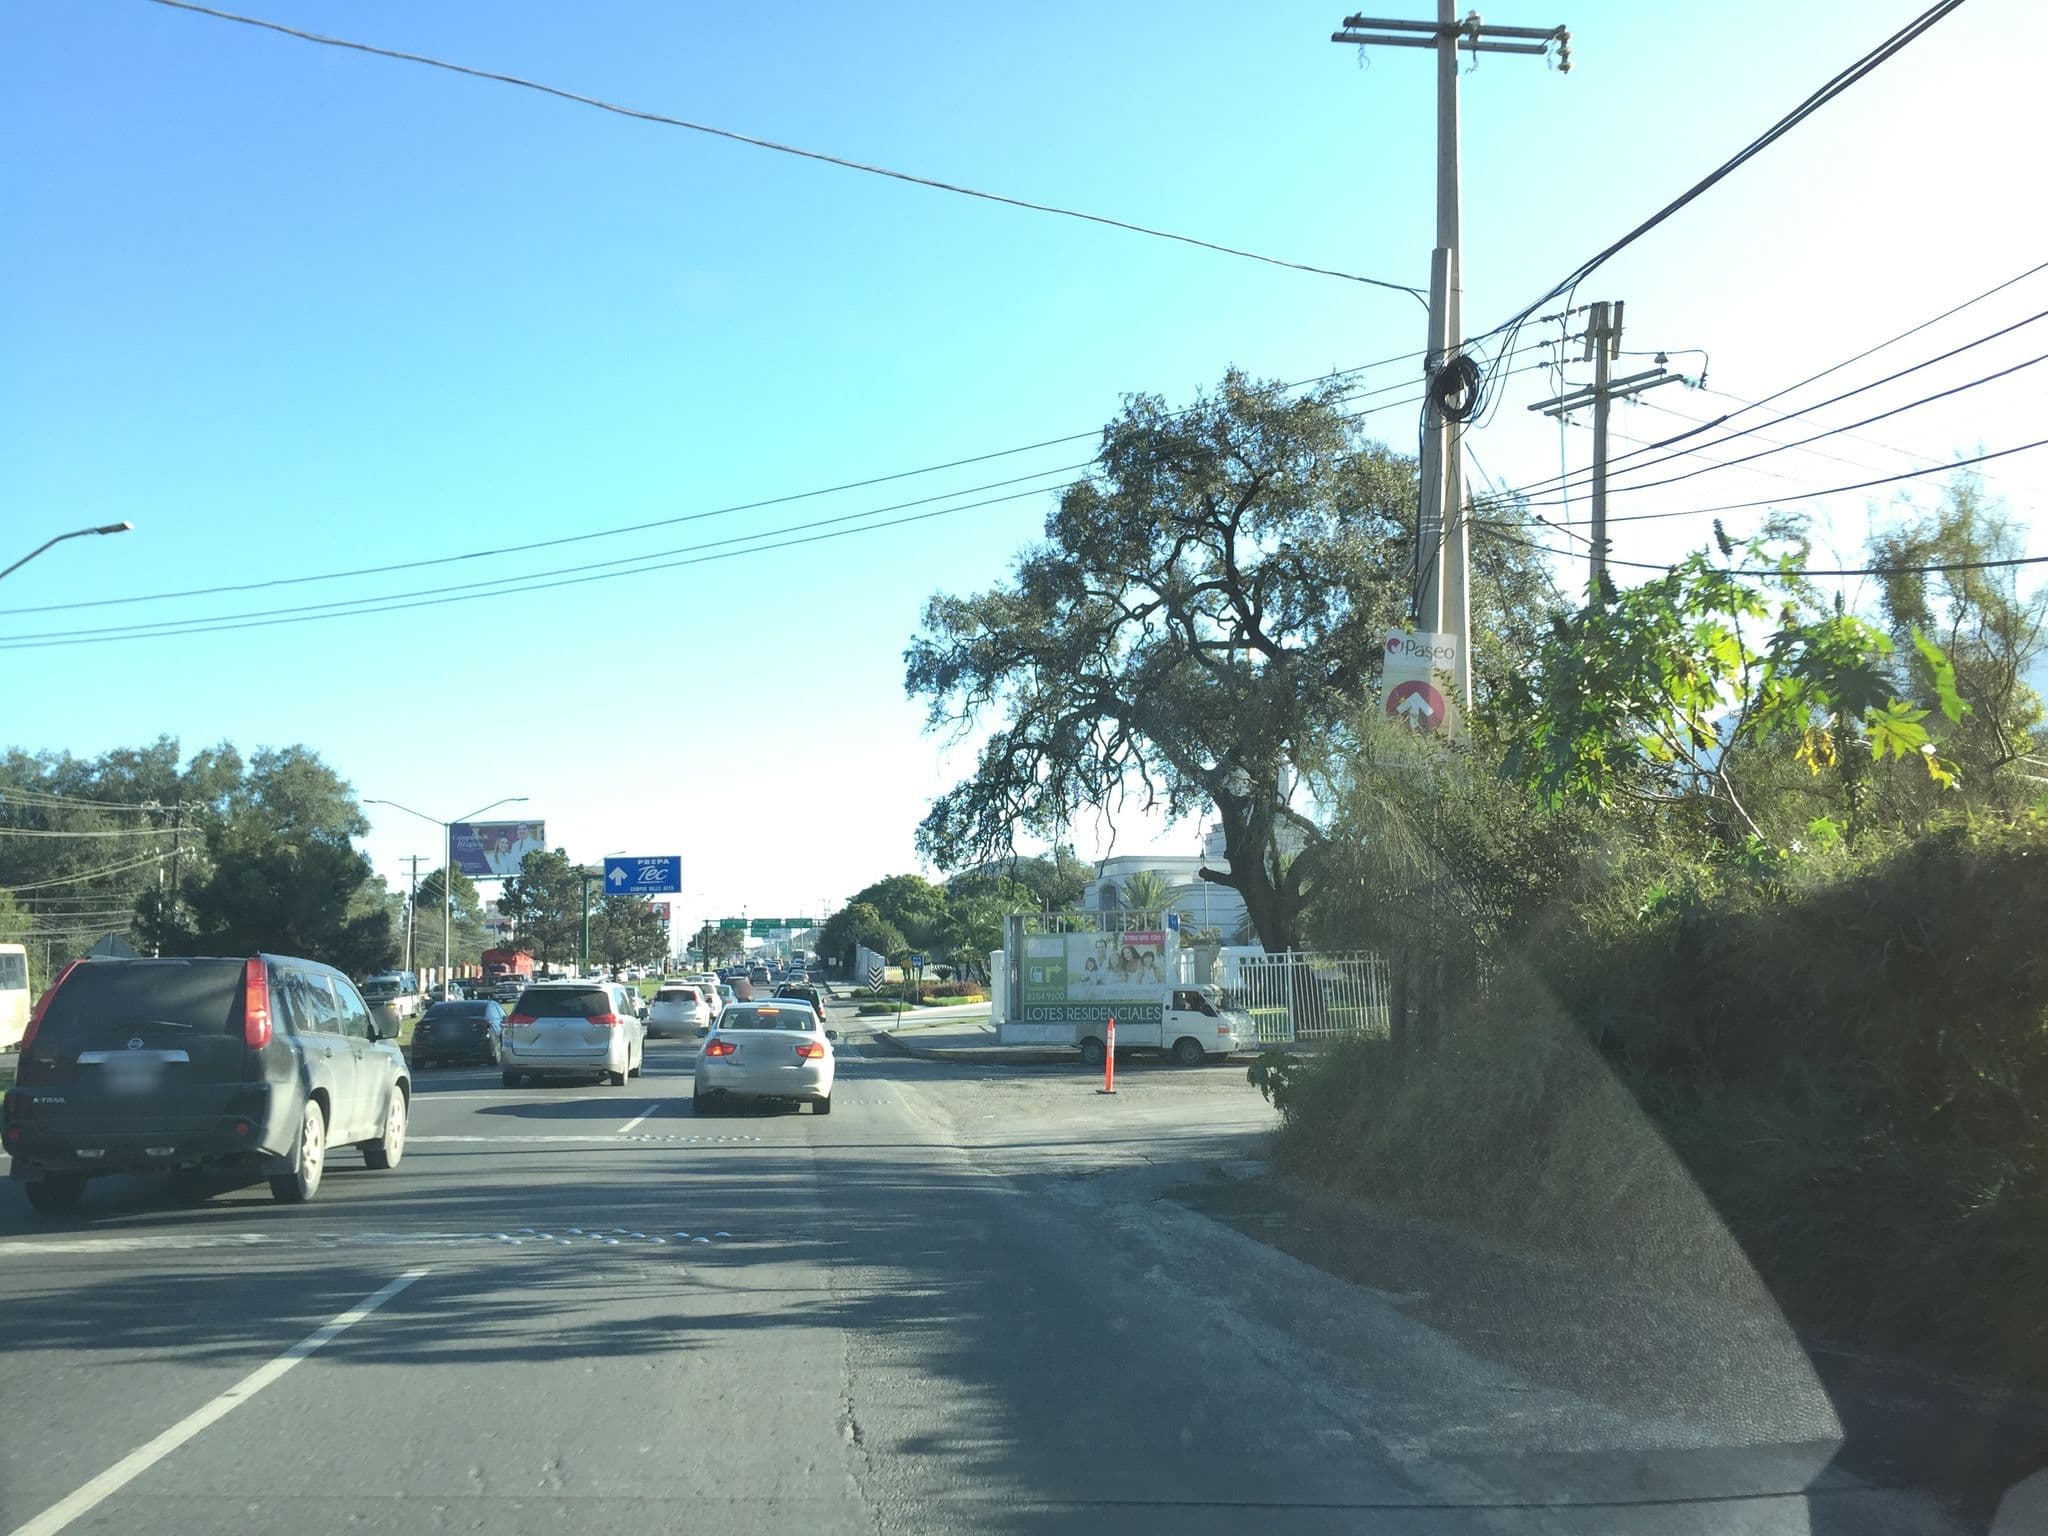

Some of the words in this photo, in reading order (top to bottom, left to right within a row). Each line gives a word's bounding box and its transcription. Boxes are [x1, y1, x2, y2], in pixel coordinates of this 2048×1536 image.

[1405, 640, 1455, 660] Paseo
[638, 865, 669, 881] Tec
[1027, 1007, 1064, 1021] LOTES
[1067, 1007, 1162, 1021] RESIDENCIALES
